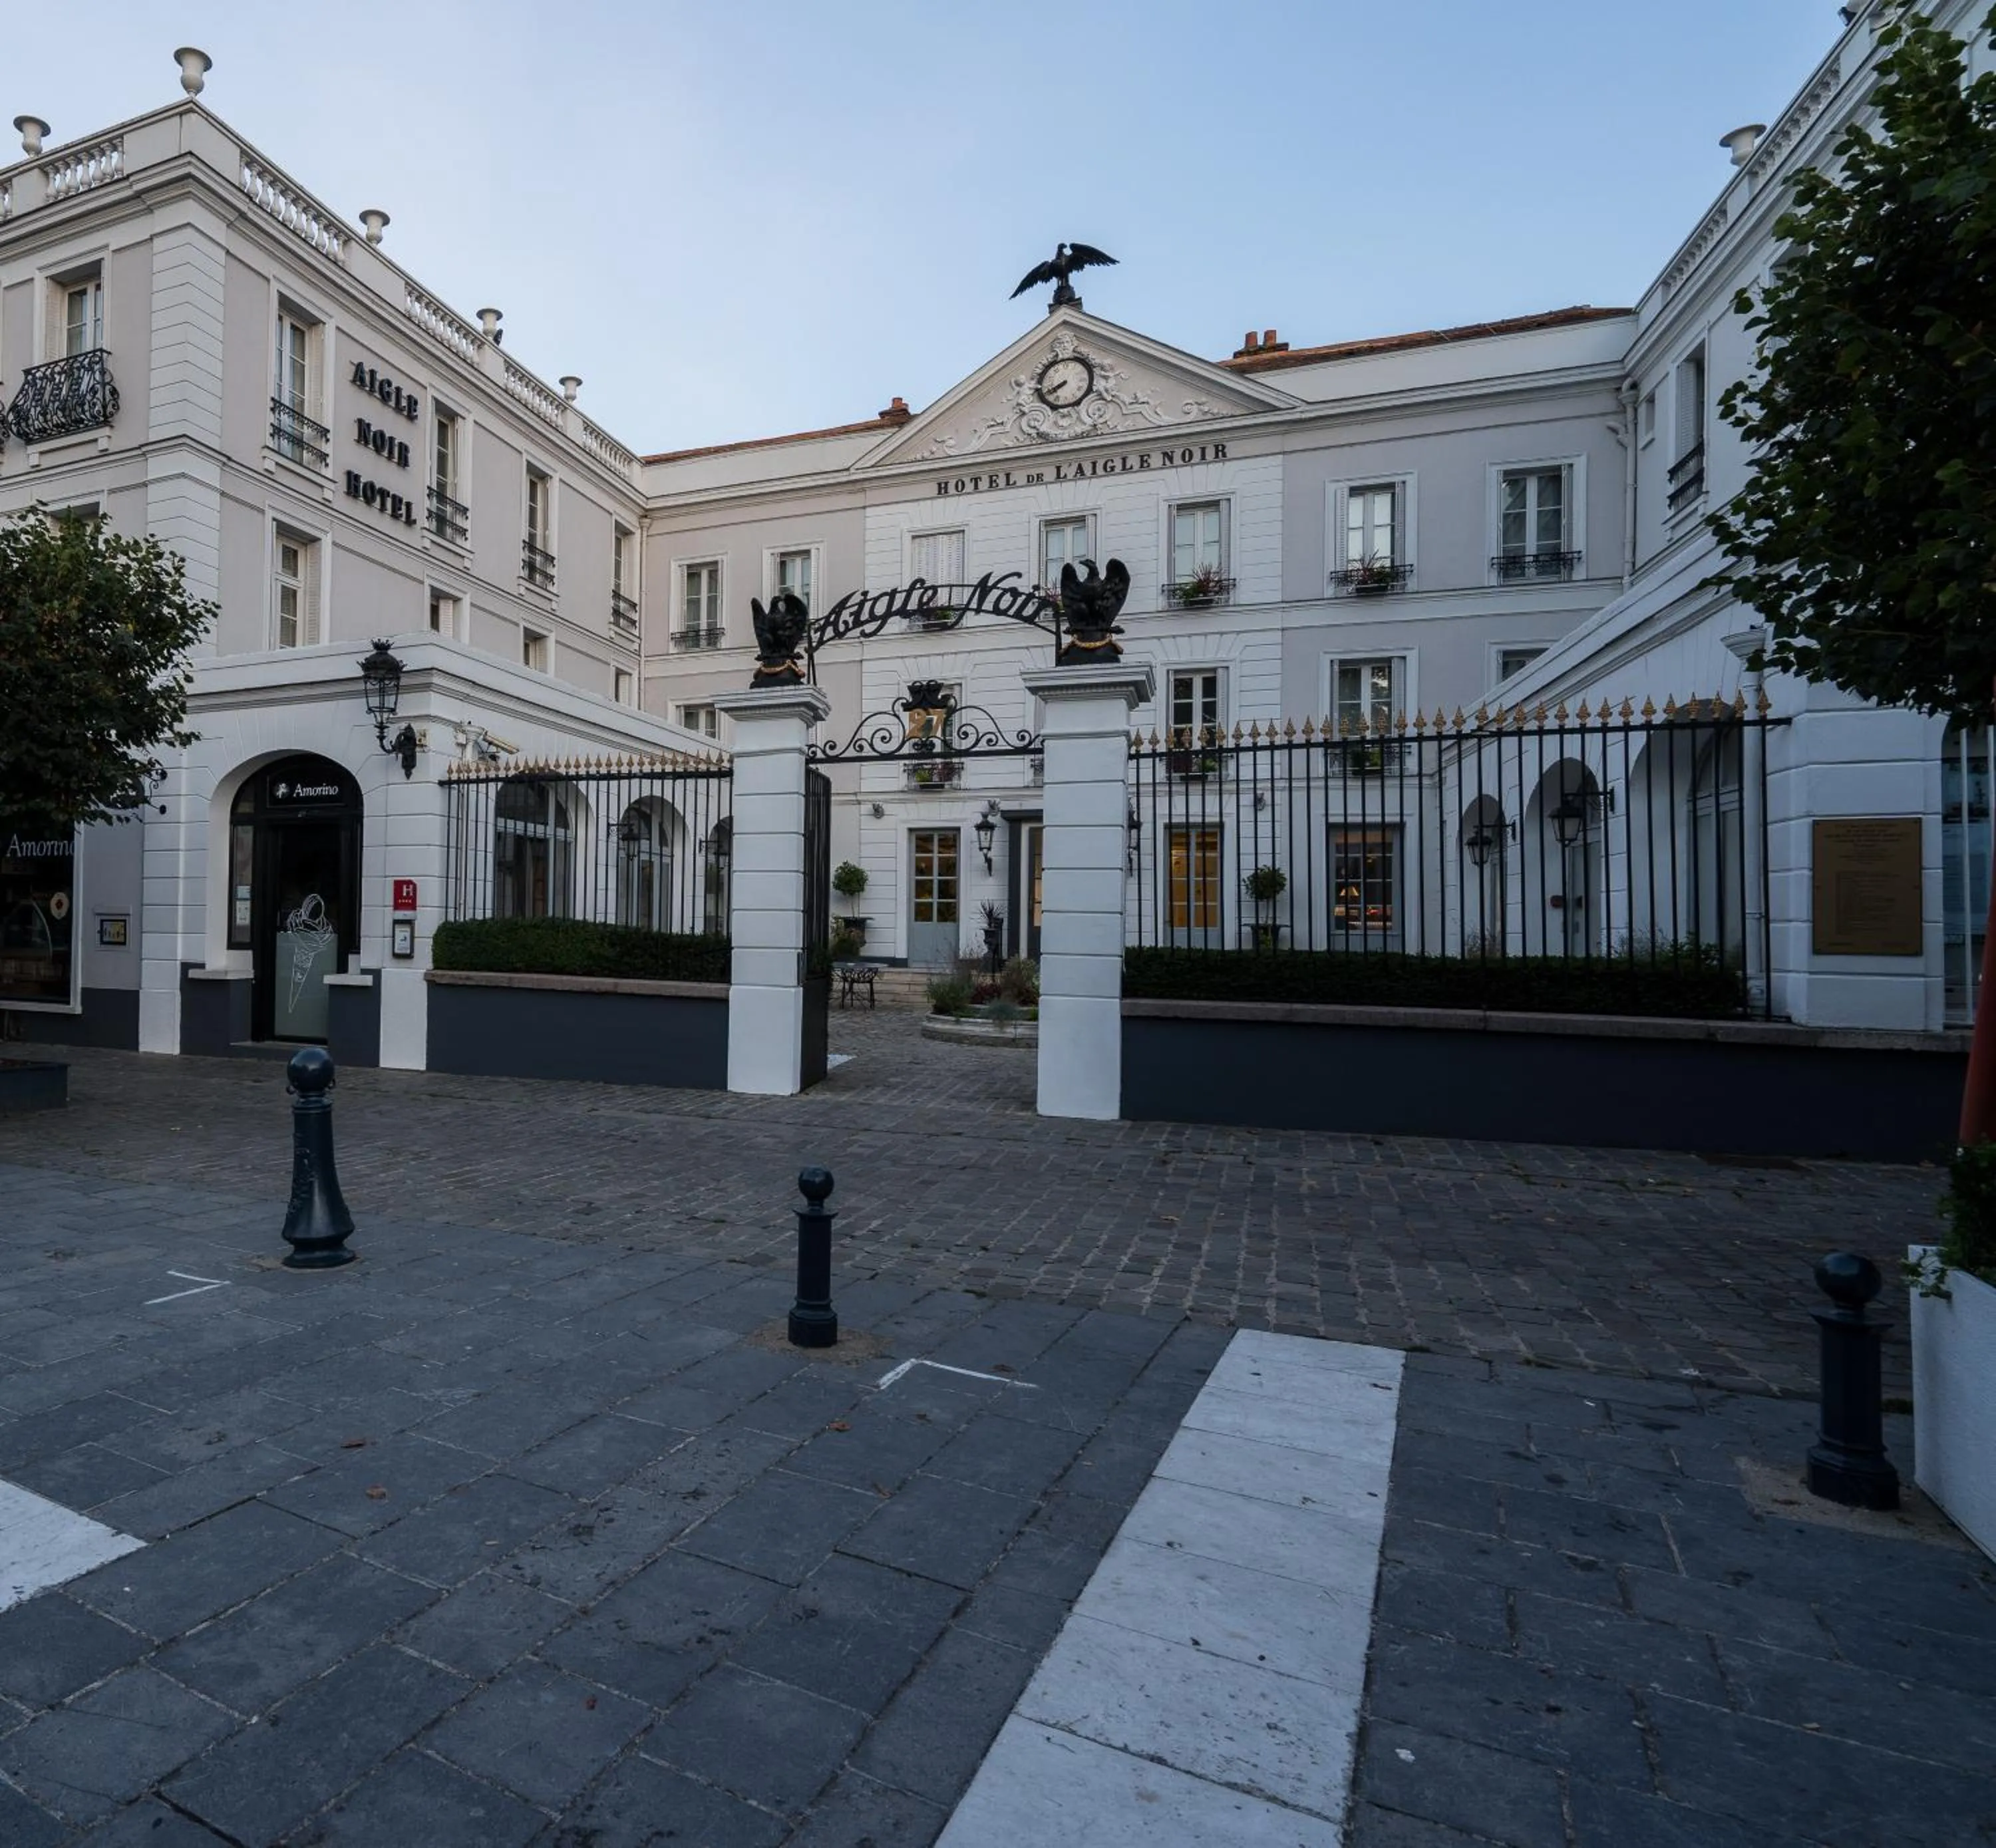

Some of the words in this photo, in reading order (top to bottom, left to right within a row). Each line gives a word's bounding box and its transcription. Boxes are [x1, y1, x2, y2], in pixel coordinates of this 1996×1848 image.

[350, 361, 418, 422] AIGLE
[355, 418, 411, 468] NOIR
[936, 472, 1017, 496] HOTEL
[1027, 472, 1044, 484] DE
[1161, 444, 1228, 466] NOIR
[345, 470, 417, 526] HOTEL
[808, 577, 939, 652] Aigle
[906, 708, 944, 738] 27
[293, 783, 339, 798] Amorino
[403, 884, 413, 896] H
